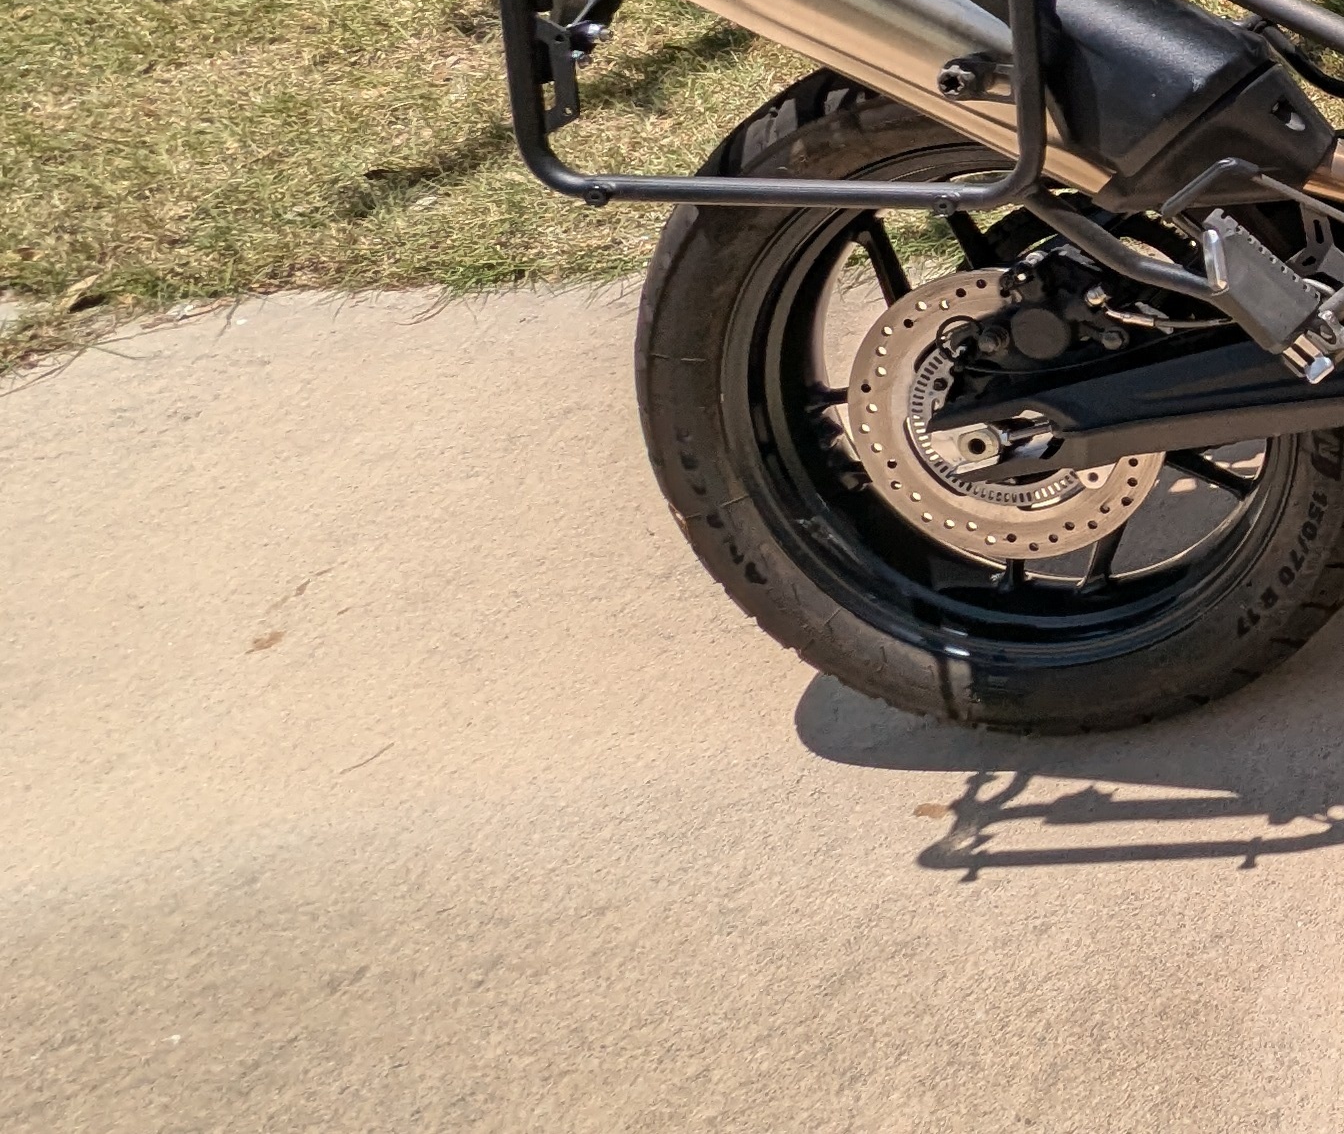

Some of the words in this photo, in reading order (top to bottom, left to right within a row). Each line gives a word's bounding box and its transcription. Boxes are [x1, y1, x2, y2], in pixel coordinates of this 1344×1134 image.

[1278, 491, 1328, 587] 150/70
[1260, 586, 1280, 610] R
[1236, 608, 1261, 638] 17
